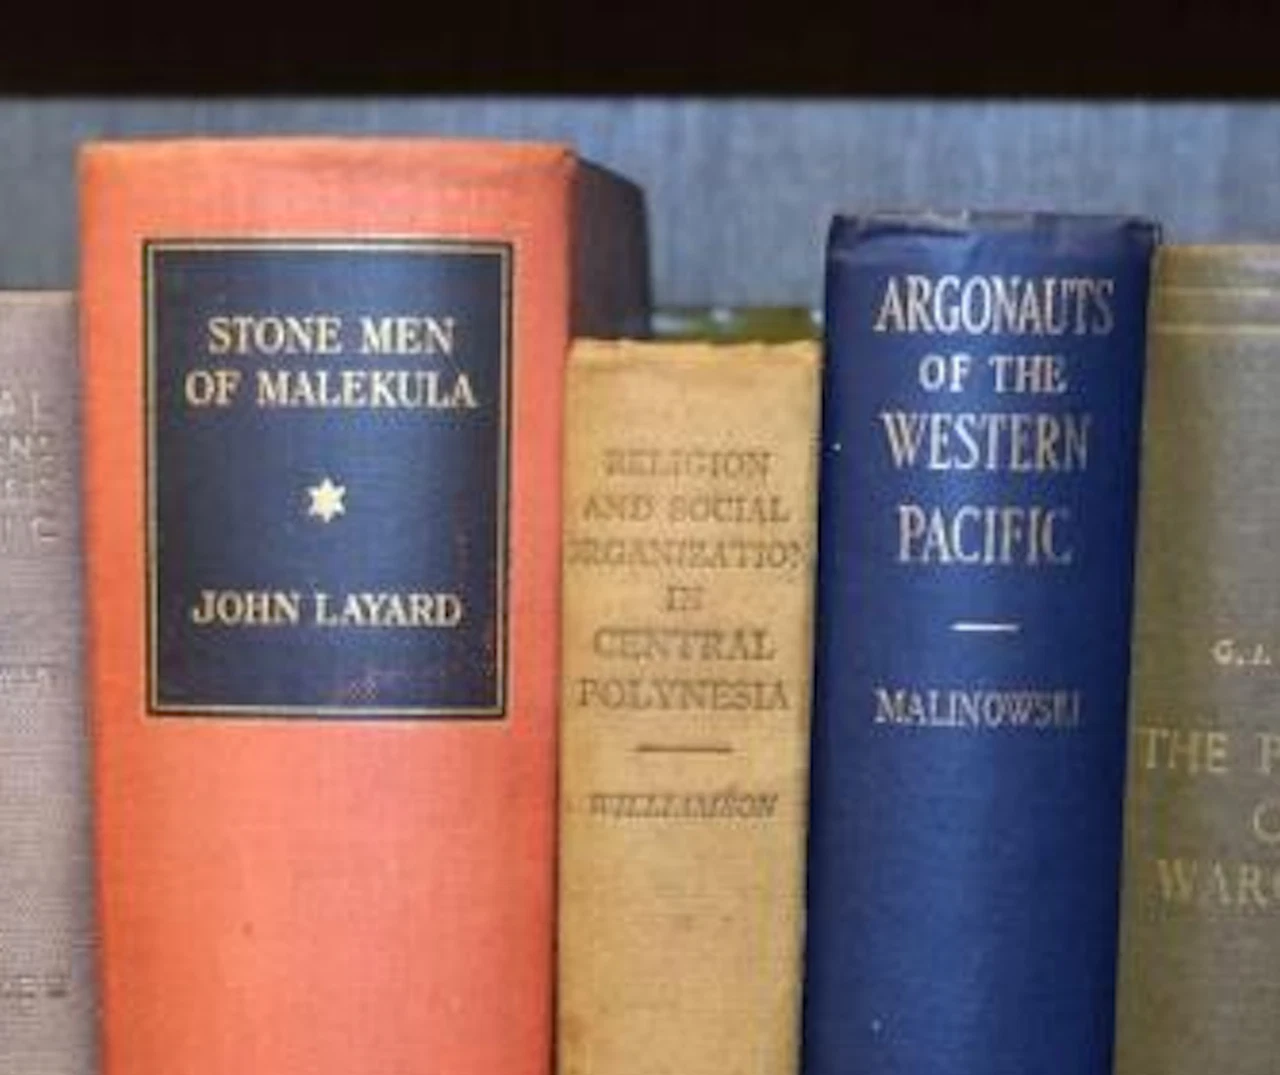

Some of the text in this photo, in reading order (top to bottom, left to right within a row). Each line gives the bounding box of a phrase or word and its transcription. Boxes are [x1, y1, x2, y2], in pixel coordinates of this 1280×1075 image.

[873, 274, 1115, 338] ARGONAUTS
[207, 315, 456, 356] STONE MEN
[184, 369, 479, 409] OF MALEKULA
[919, 353, 1069, 394] OF THE
[881, 410, 1092, 472] WESTERN
[604, 448, 774, 479] RELIGION
[582, 495, 791, 524] AND SOCIAL
[898, 504, 1073, 567] PACIFIC
[192, 589, 464, 628] JOHN LAYARD
[593, 626, 778, 662] CENTRAL
[579, 677, 791, 712] POLYNESIA
[874, 687, 1082, 728] MALINOWSKI
[1135, 726, 1230, 775] THE
